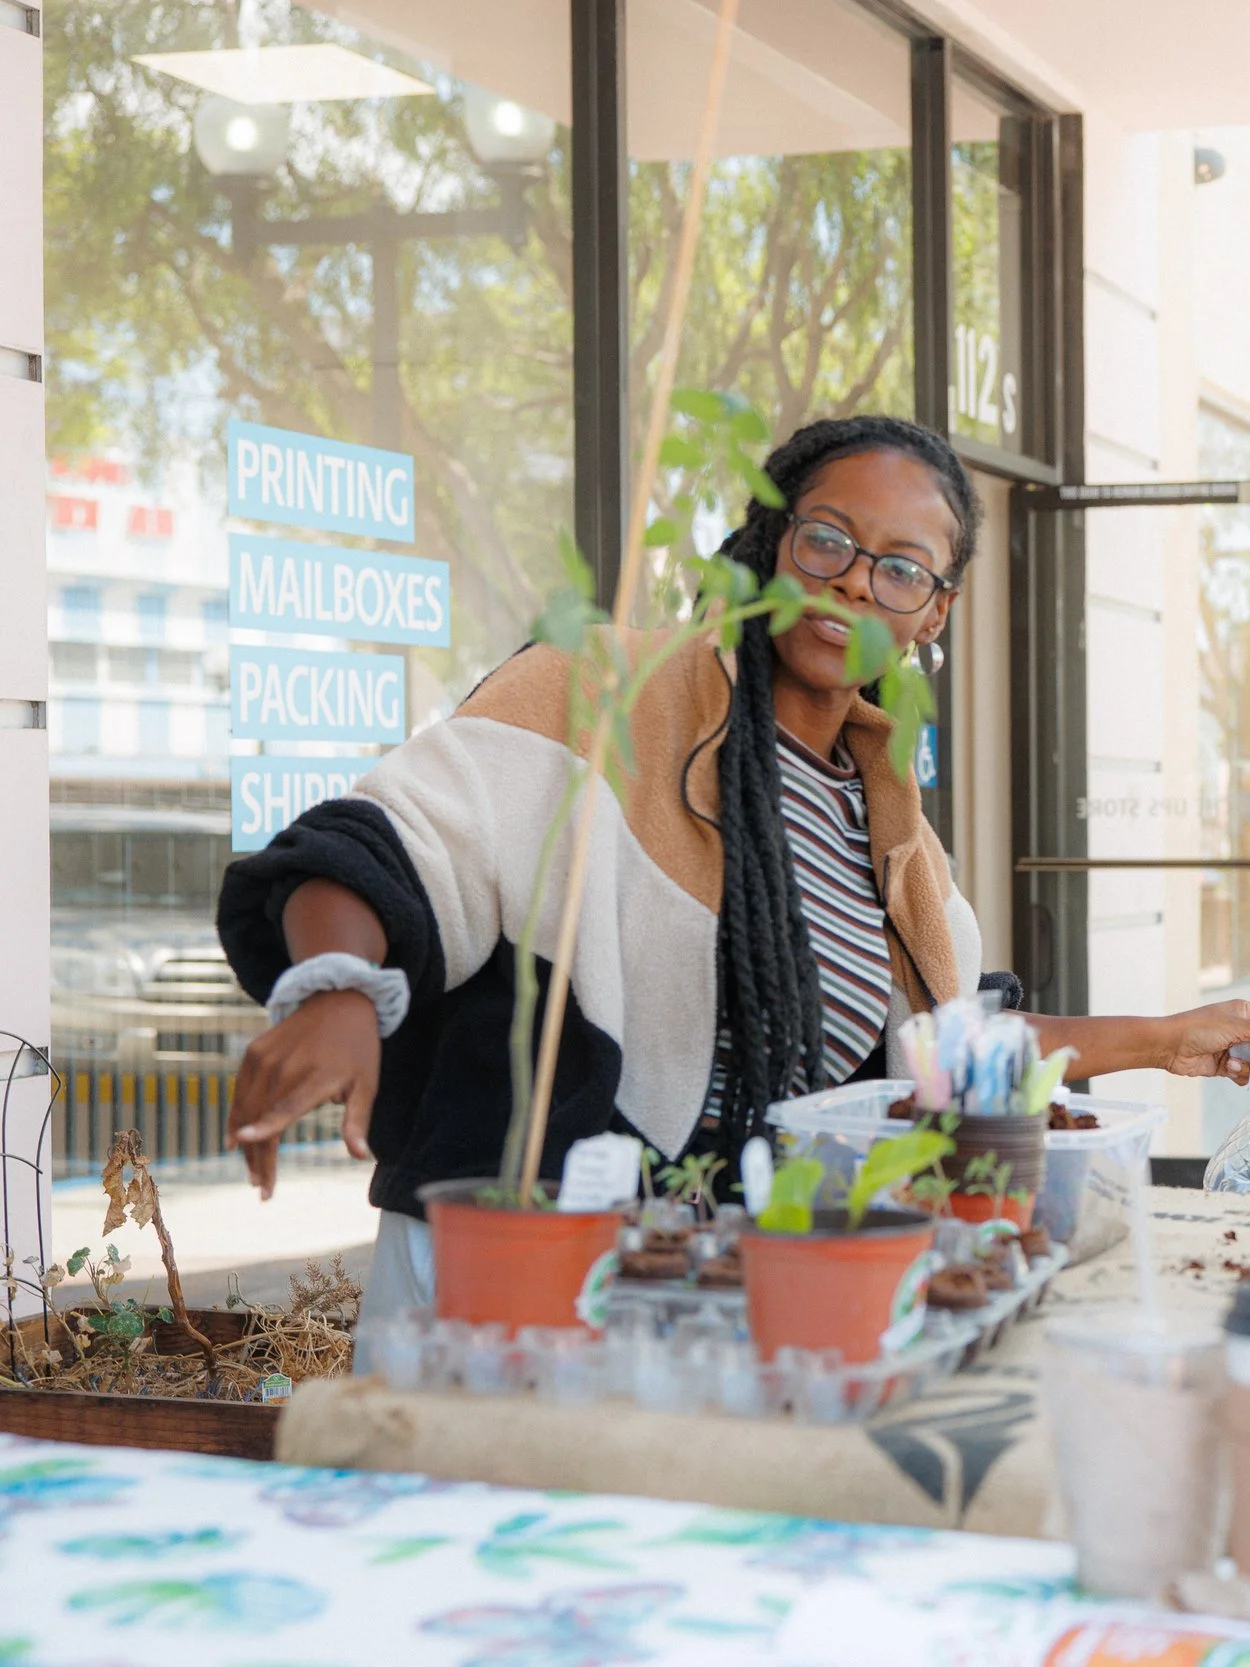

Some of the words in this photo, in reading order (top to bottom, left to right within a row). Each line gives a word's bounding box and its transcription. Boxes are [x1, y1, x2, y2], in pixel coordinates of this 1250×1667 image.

[236, 438, 408, 526] PRINTING
[238, 551, 443, 632] MAILBOXES
[239, 661, 399, 728] PACKING
[240, 771, 367, 834] SHIPP
